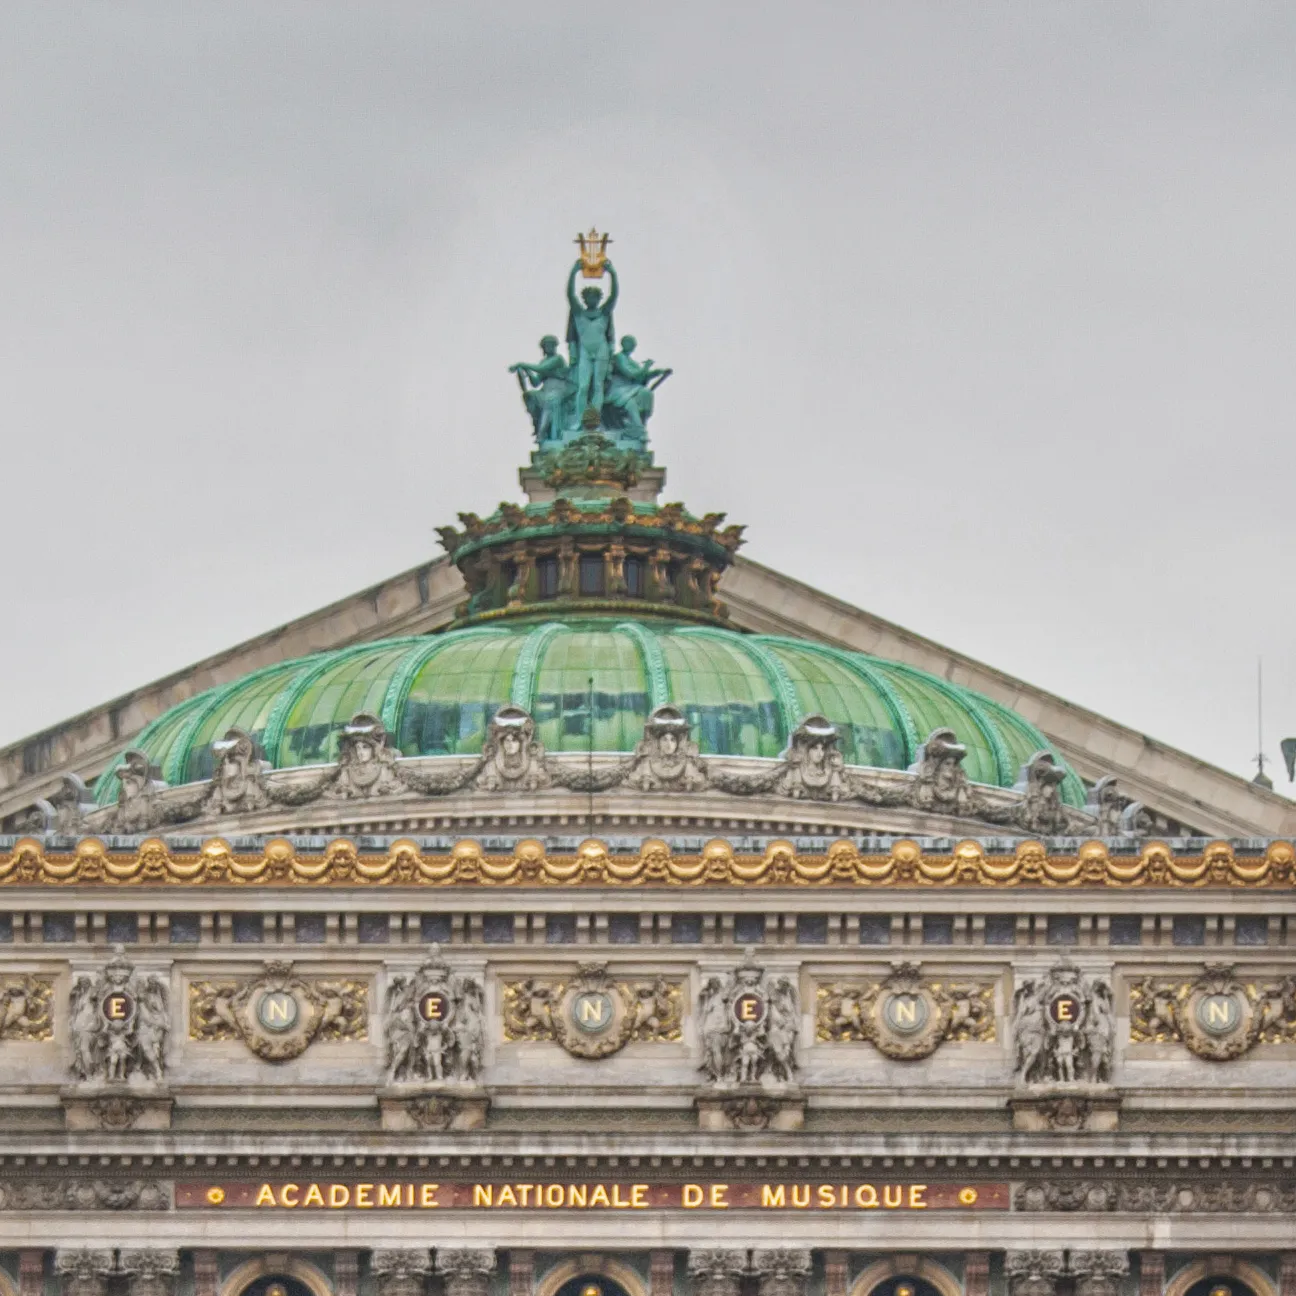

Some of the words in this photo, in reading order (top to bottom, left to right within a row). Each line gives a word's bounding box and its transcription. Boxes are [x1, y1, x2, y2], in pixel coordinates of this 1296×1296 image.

[109, 998, 126, 1018] E
[268, 999, 288, 1021] N
[425, 998, 442, 1019] E
[581, 999, 602, 1021] N
[741, 1000, 757, 1020] E
[895, 1000, 915, 1022] N
[1057, 1000, 1073, 1020] E
[1209, 1000, 1229, 1022] N
[256, 1183, 440, 1208] ACADEMIE
[472, 1183, 650, 1208] NATIONALE
[682, 1184, 729, 1208] DE
[761, 1184, 928, 1208] MUSIQUE
